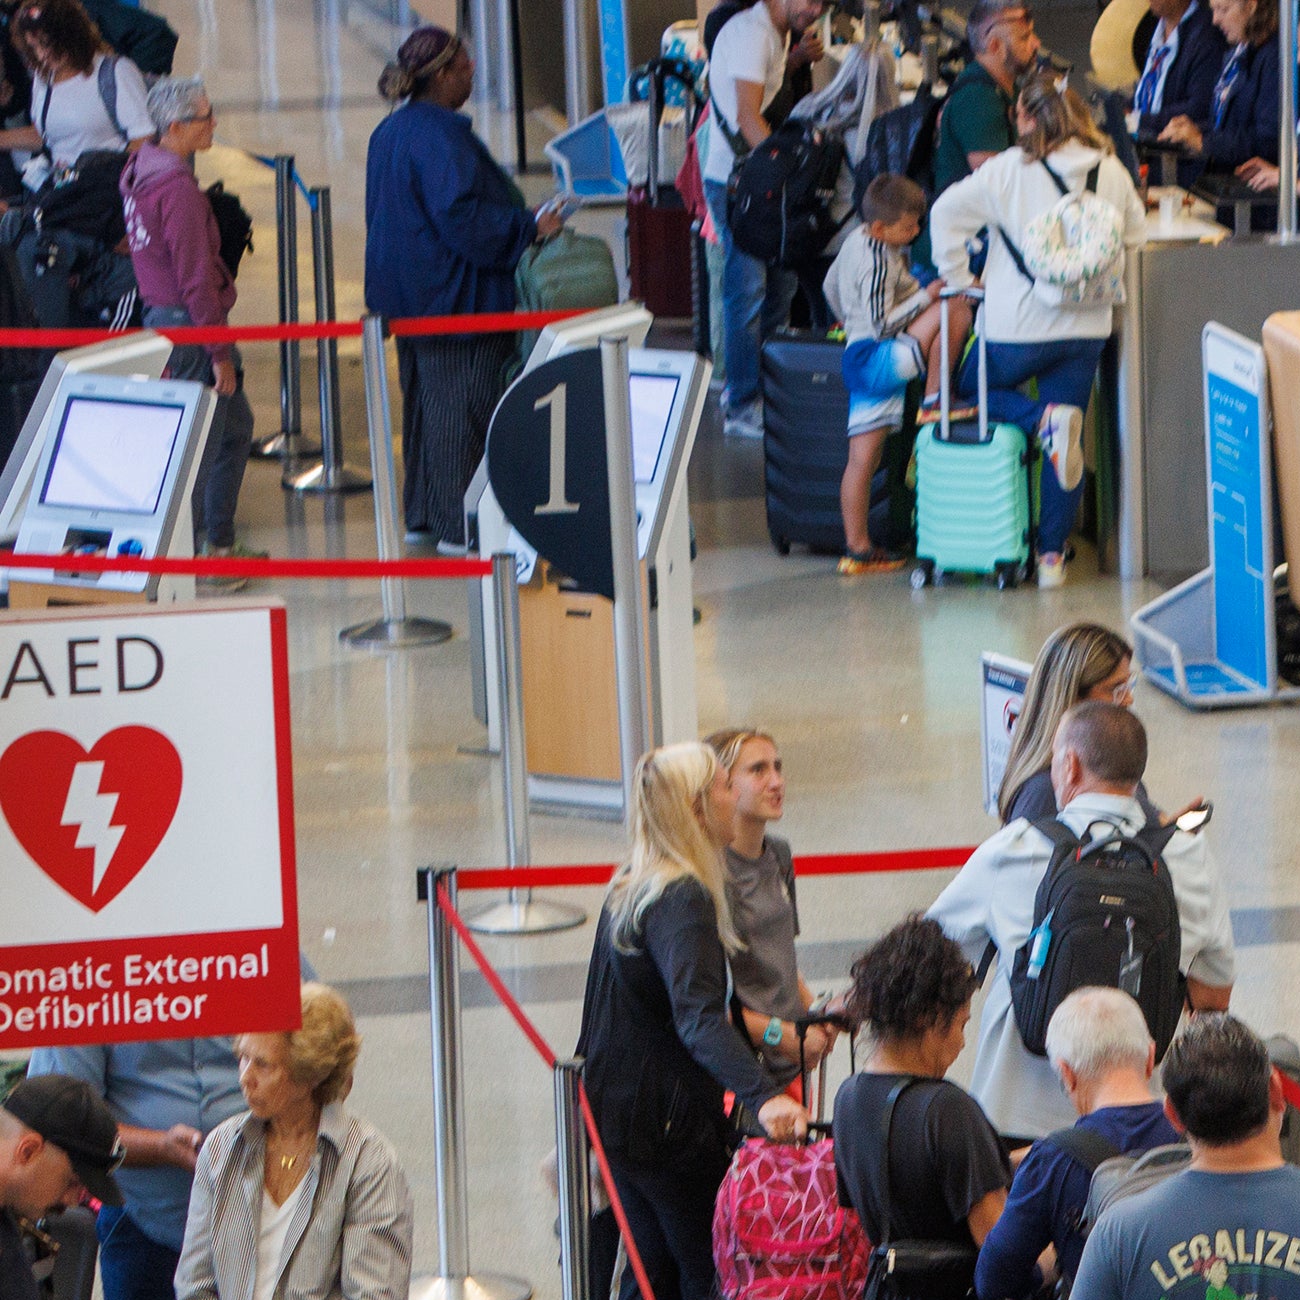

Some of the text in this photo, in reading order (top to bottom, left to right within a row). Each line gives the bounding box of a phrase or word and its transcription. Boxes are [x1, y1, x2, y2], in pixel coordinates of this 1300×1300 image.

[533, 383, 581, 515] 1
[1, 634, 165, 699] AED
[124, 943, 269, 987] External
